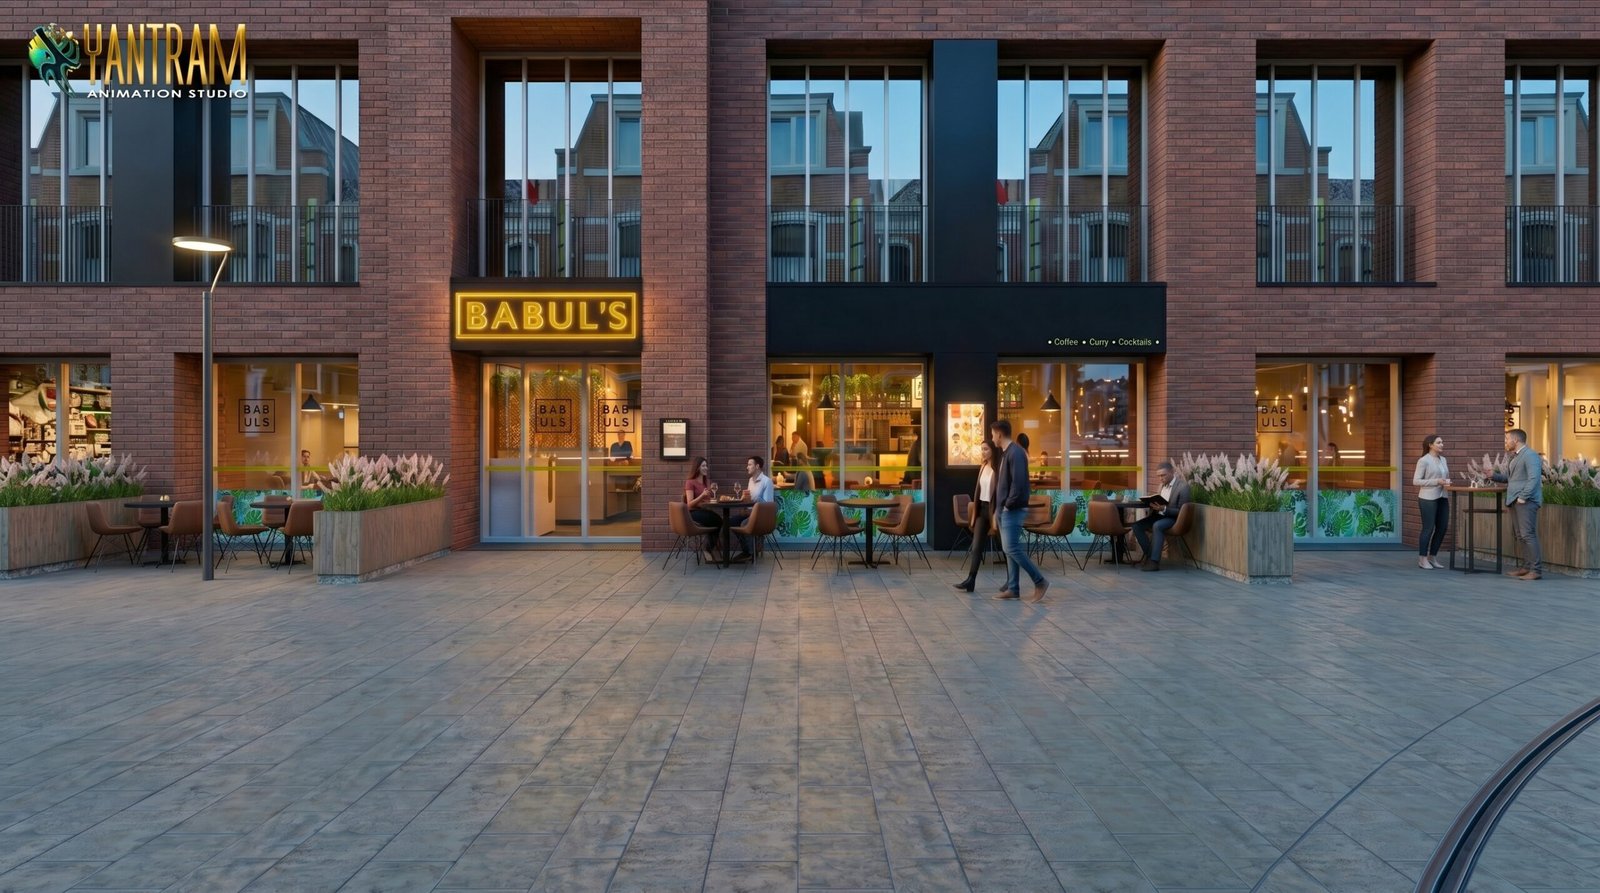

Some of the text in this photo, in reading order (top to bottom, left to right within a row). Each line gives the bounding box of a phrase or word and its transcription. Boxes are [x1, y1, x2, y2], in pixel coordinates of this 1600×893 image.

[466, 301, 628, 330] BABUL'S
[1054, 338, 1152, 347] Coffee Curry Cocktails
[243, 404, 270, 414] BAB
[540, 404, 566, 414] BAB
[602, 404, 629, 414] BAB
[1261, 404, 1287, 414] BAB
[1579, 404, 1600, 414] BA
[244, 417, 270, 427] ULS
[540, 418, 566, 427] ULS
[603, 418, 629, 427] ULS
[1261, 417, 1287, 427] ULS
